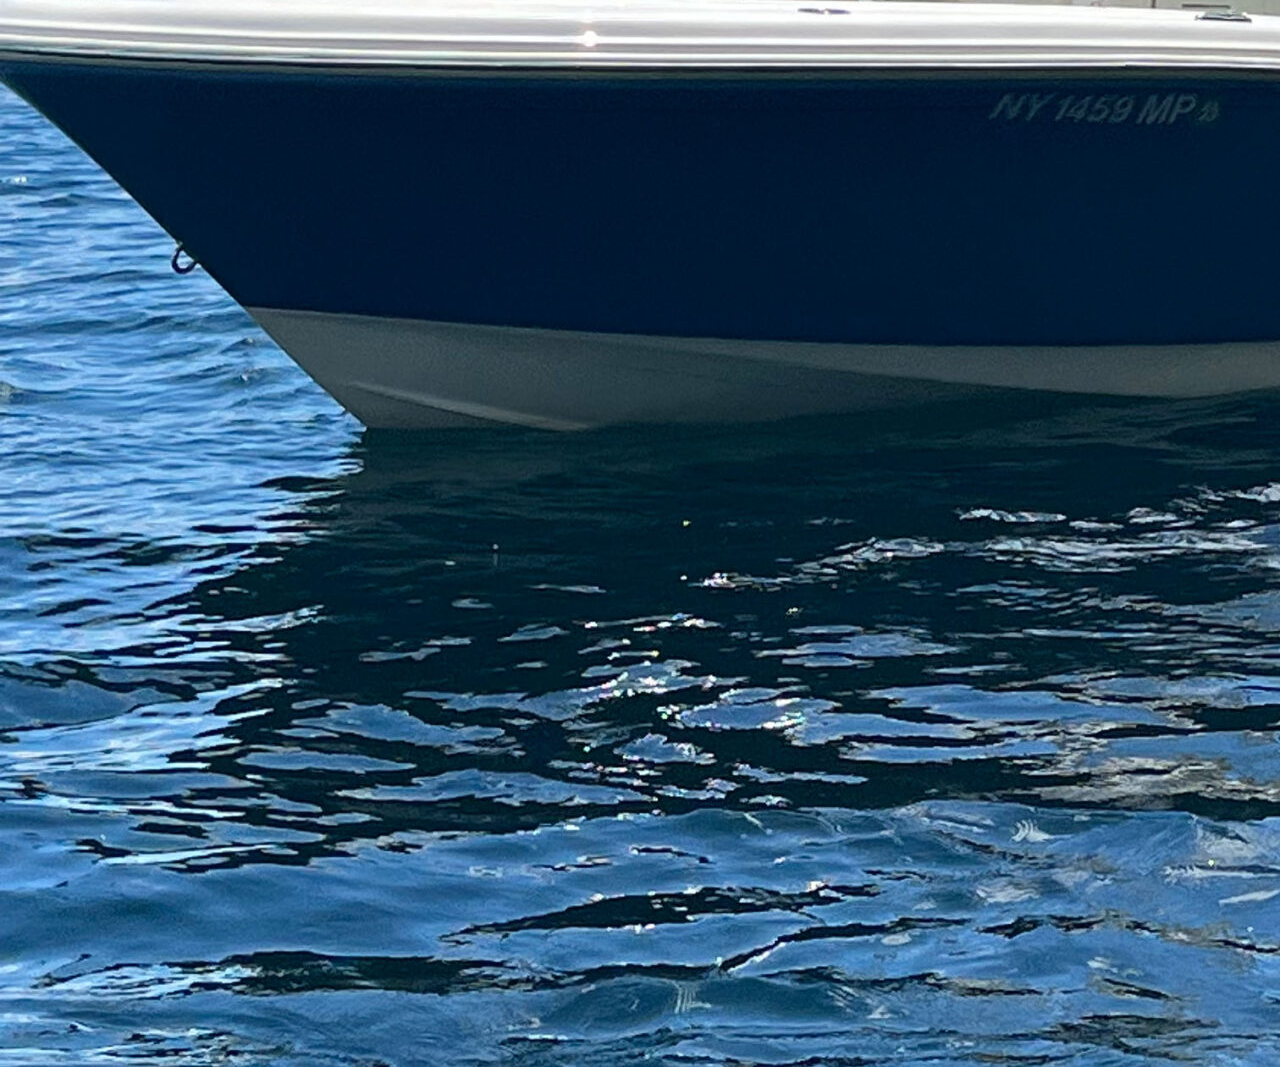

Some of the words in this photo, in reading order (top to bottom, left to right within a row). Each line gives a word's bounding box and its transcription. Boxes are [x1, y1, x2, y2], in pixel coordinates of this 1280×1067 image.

[988, 92, 1055, 122] NY
[1054, 94, 1136, 124] 1459
[1135, 92, 1199, 125] MP
